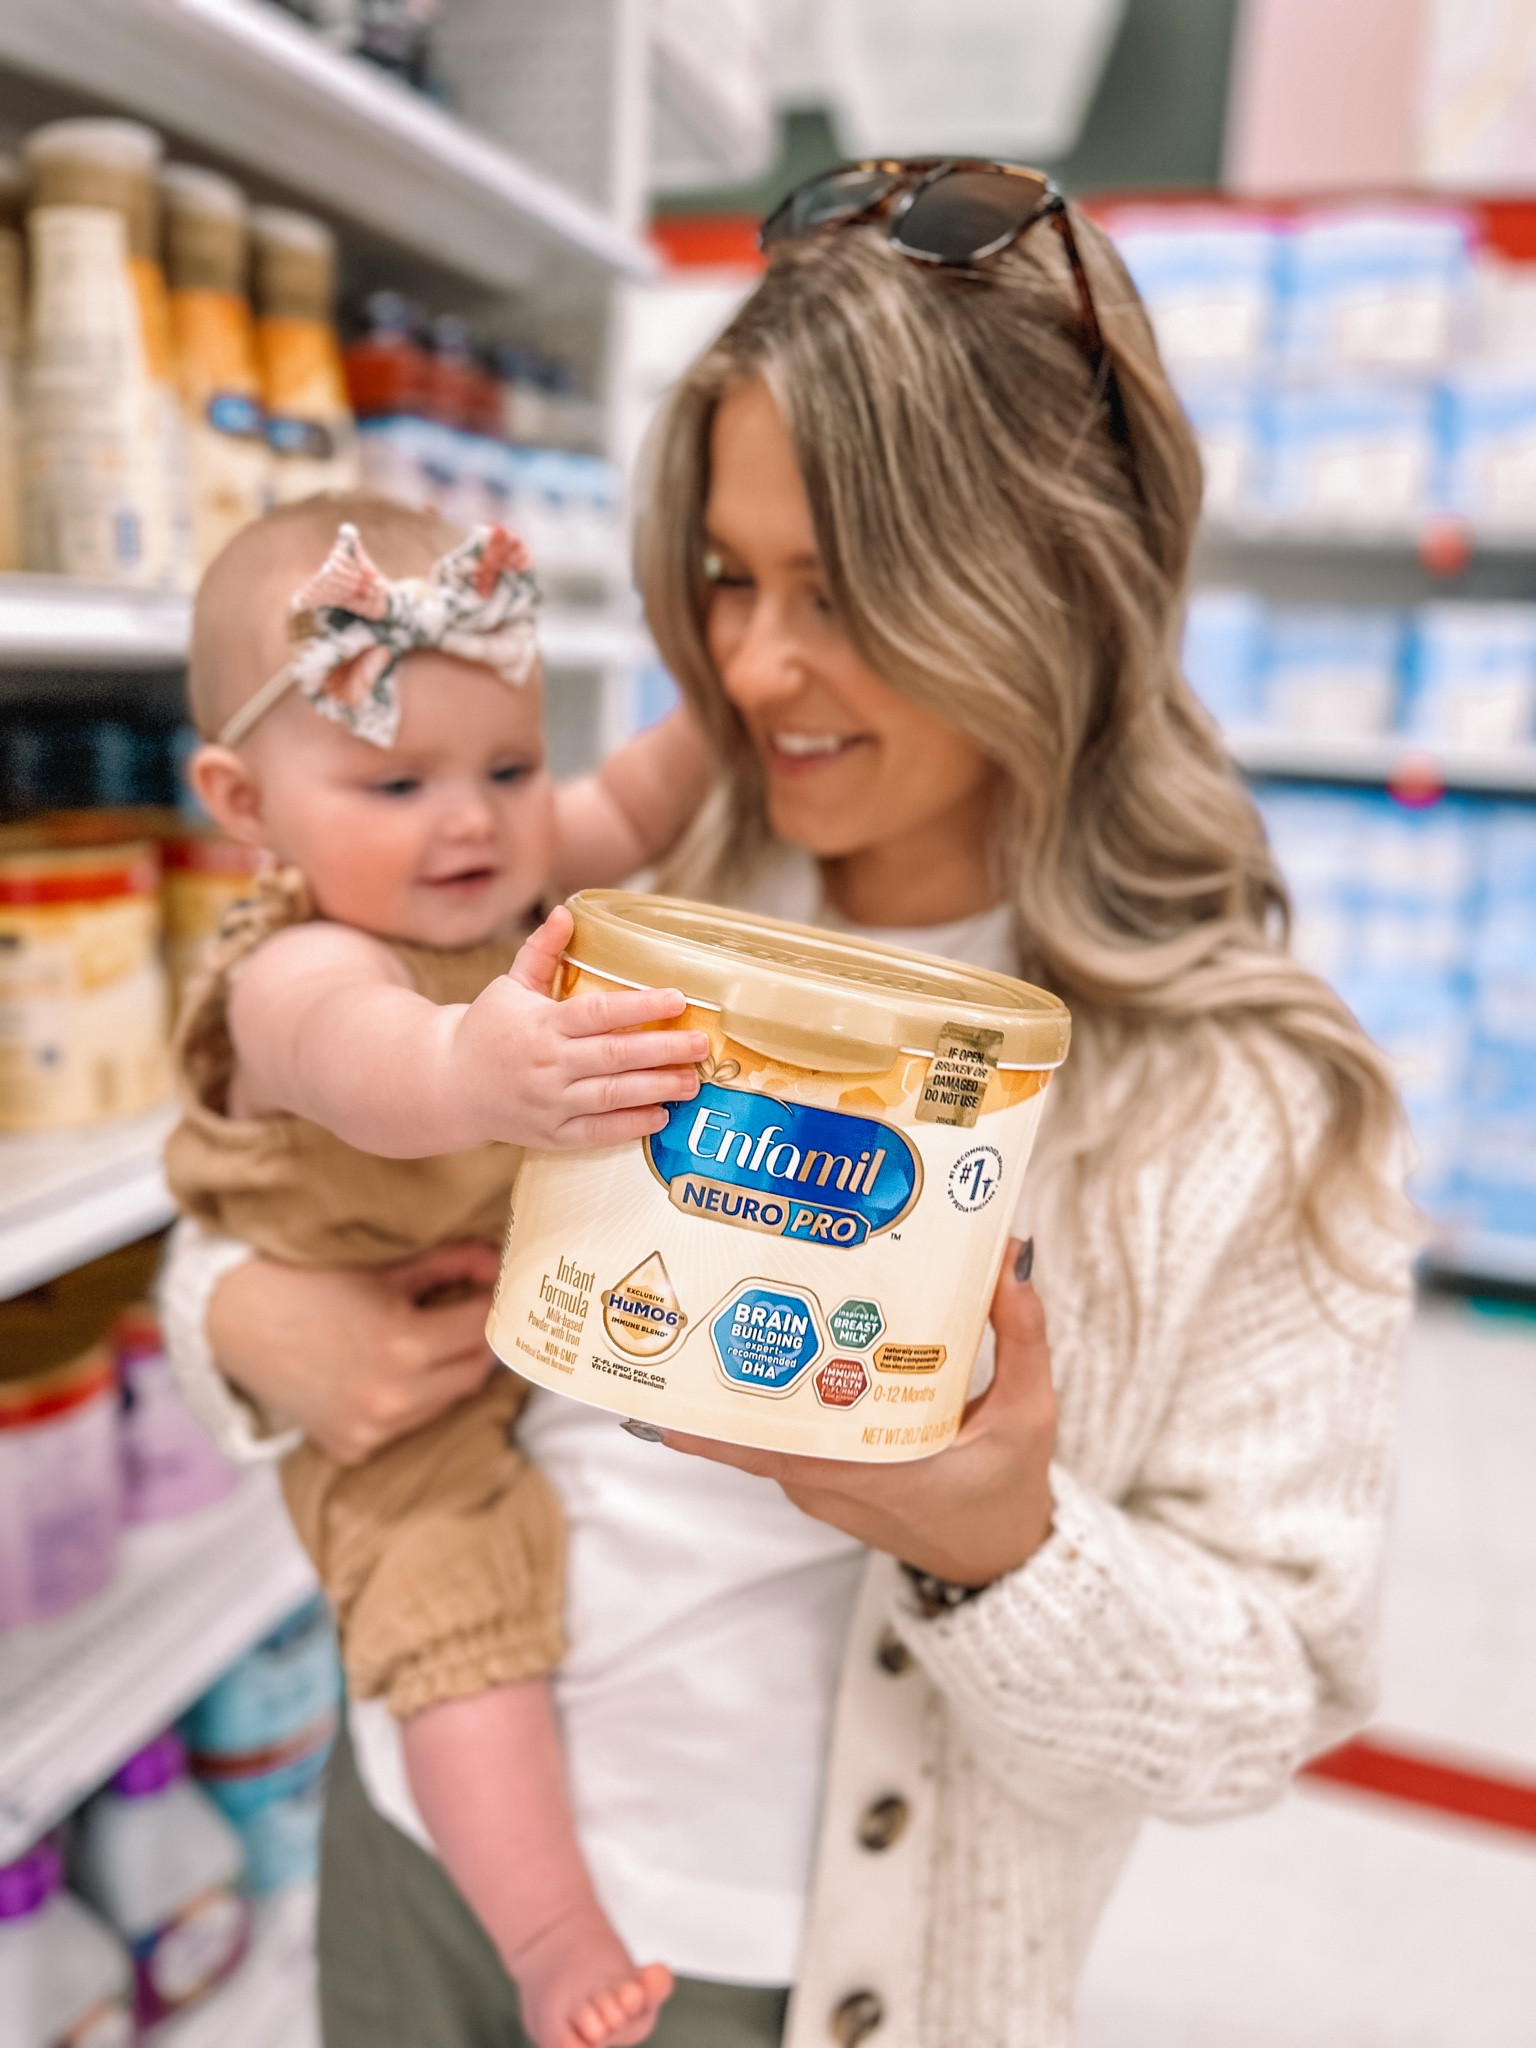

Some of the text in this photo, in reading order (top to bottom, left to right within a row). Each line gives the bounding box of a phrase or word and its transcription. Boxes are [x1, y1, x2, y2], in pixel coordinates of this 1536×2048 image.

[948, 1047, 959, 1059] IF
[935, 1061, 988, 1079] BROKEN OR
[933, 1075, 979, 1093] DAMAGED
[925, 1088, 979, 1109] DO NOT USE
[687, 1106, 887, 1196] Enfamil
[683, 1182, 857, 1242] NEURO PRO
[556, 1255, 596, 1293] Infant
[539, 1274, 589, 1318] Formula
[626, 1287, 665, 1303] EXCLUSIVE
[546, 1306, 584, 1333] Milk-based
[611, 1316, 640, 1331] IMMUNE
[734, 1302, 809, 1336] BRAIN
[838, 1310, 879, 1322] inspired by
[528, 1310, 581, 1346] Powder with Iron
[834, 1317, 879, 1335] BREAST
[731, 1323, 804, 1350] BUILDING
[839, 1330, 868, 1343] MILK
[727, 1347, 798, 1368] recommended
[745, 1342, 783, 1355] expert-
[742, 1360, 777, 1380] DHA
[824, 1367, 864, 1380] IMMUNE
[619, 1371, 632, 1380] and
[633, 1376, 665, 1391] Selenium
[821, 1375, 862, 1390] HEALTH
[874, 1384, 900, 1403] 0-12
[901, 1386, 936, 1403] Months
[862, 1426, 883, 1444] NET
[885, 1427, 901, 1445] WT
